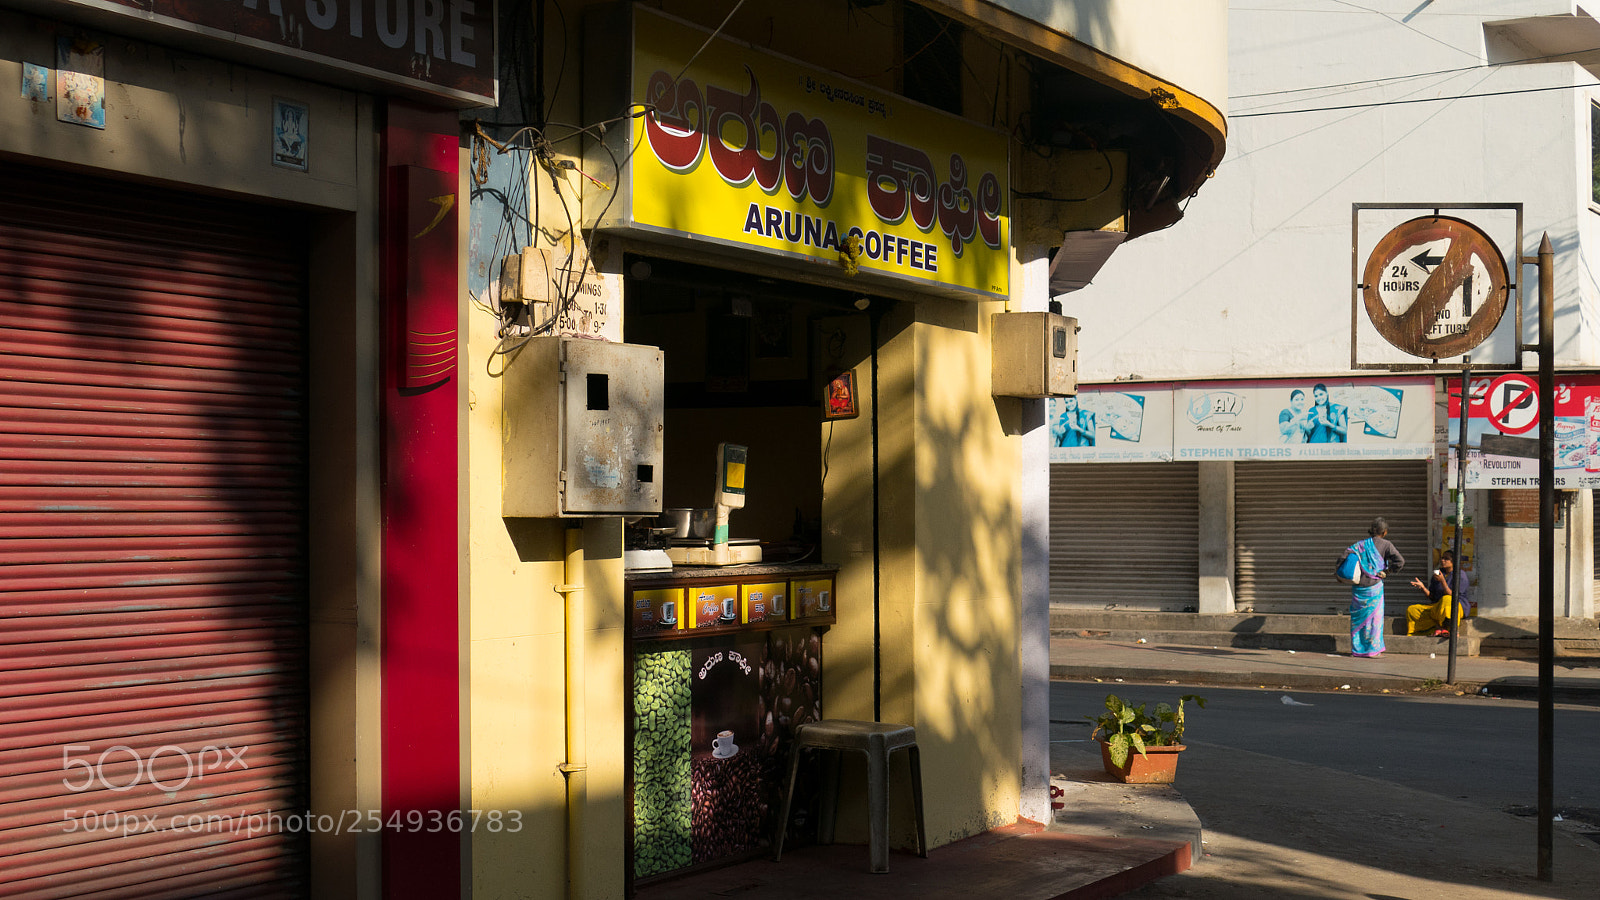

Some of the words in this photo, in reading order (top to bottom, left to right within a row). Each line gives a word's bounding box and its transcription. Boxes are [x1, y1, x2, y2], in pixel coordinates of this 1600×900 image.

[645, 64, 835, 207] ಅರುಣ
[743, 203, 840, 251] ARUNA
[847, 226, 938, 272] COFFEE
[1391, 266, 1408, 278] 24
[1383, 281, 1420, 292] HOURS
[1438, 309, 1450, 319] NO
[1215, 425, 1224, 433] Of
[1225, 424, 1242, 432] Taste
[1180, 448, 1234, 457] STEPHEN
[1236, 447, 1292, 457] TRADERS
[1491, 477, 1528, 486] STEPHEN
[1529, 477, 1566, 486] TRRS
